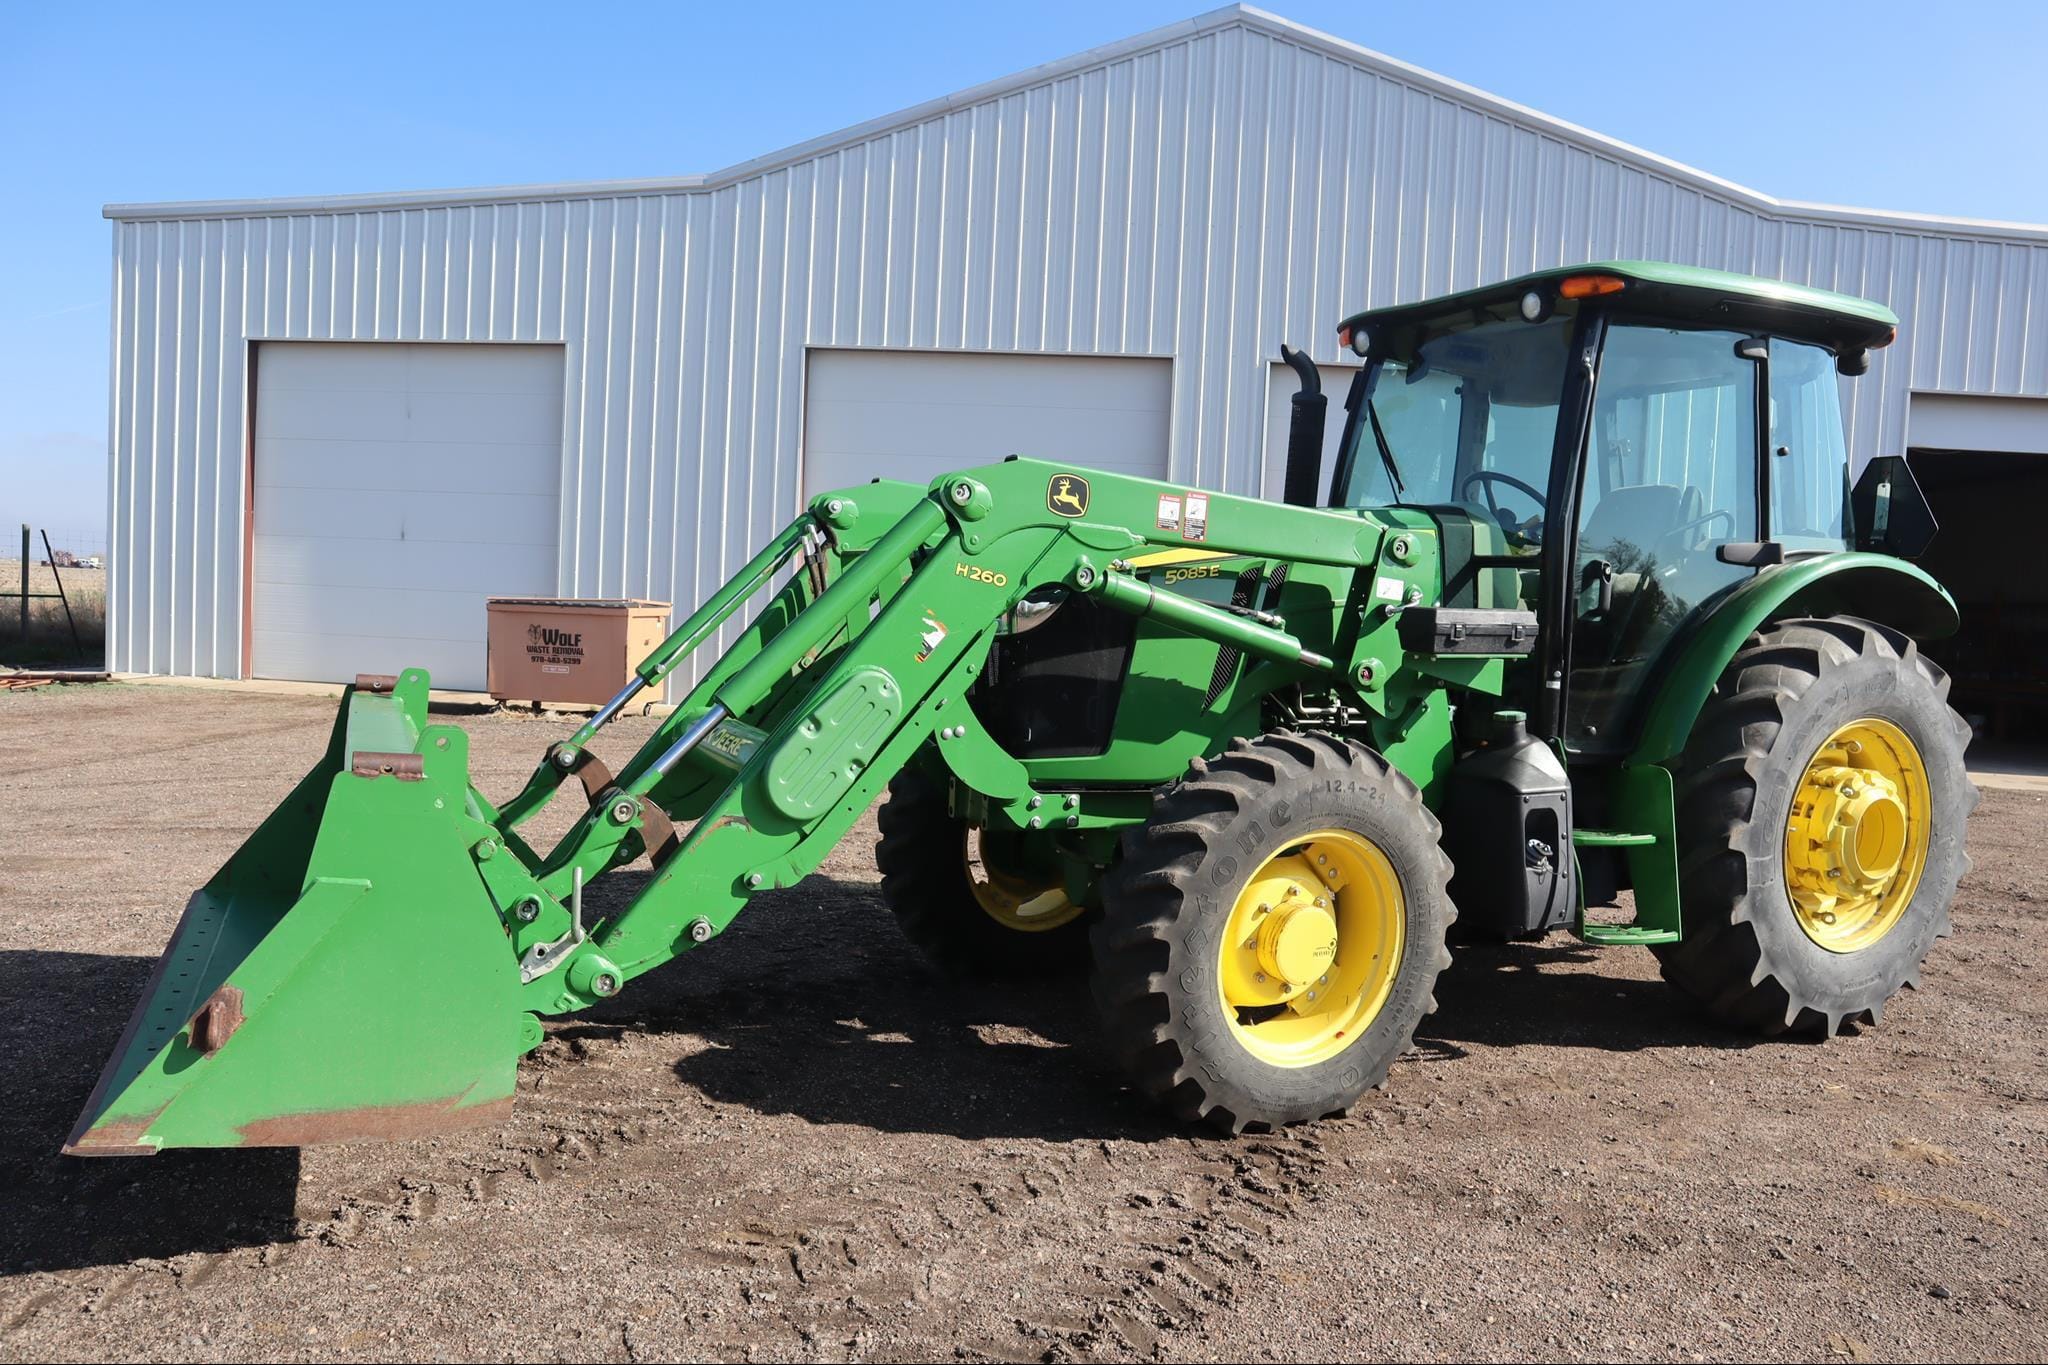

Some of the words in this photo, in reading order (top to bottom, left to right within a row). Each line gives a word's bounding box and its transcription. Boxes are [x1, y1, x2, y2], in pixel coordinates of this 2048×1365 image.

[955, 562, 1007, 587] H260
[526, 645, 550, 654] WASTE
[551, 647, 585, 656] REMOVAL
